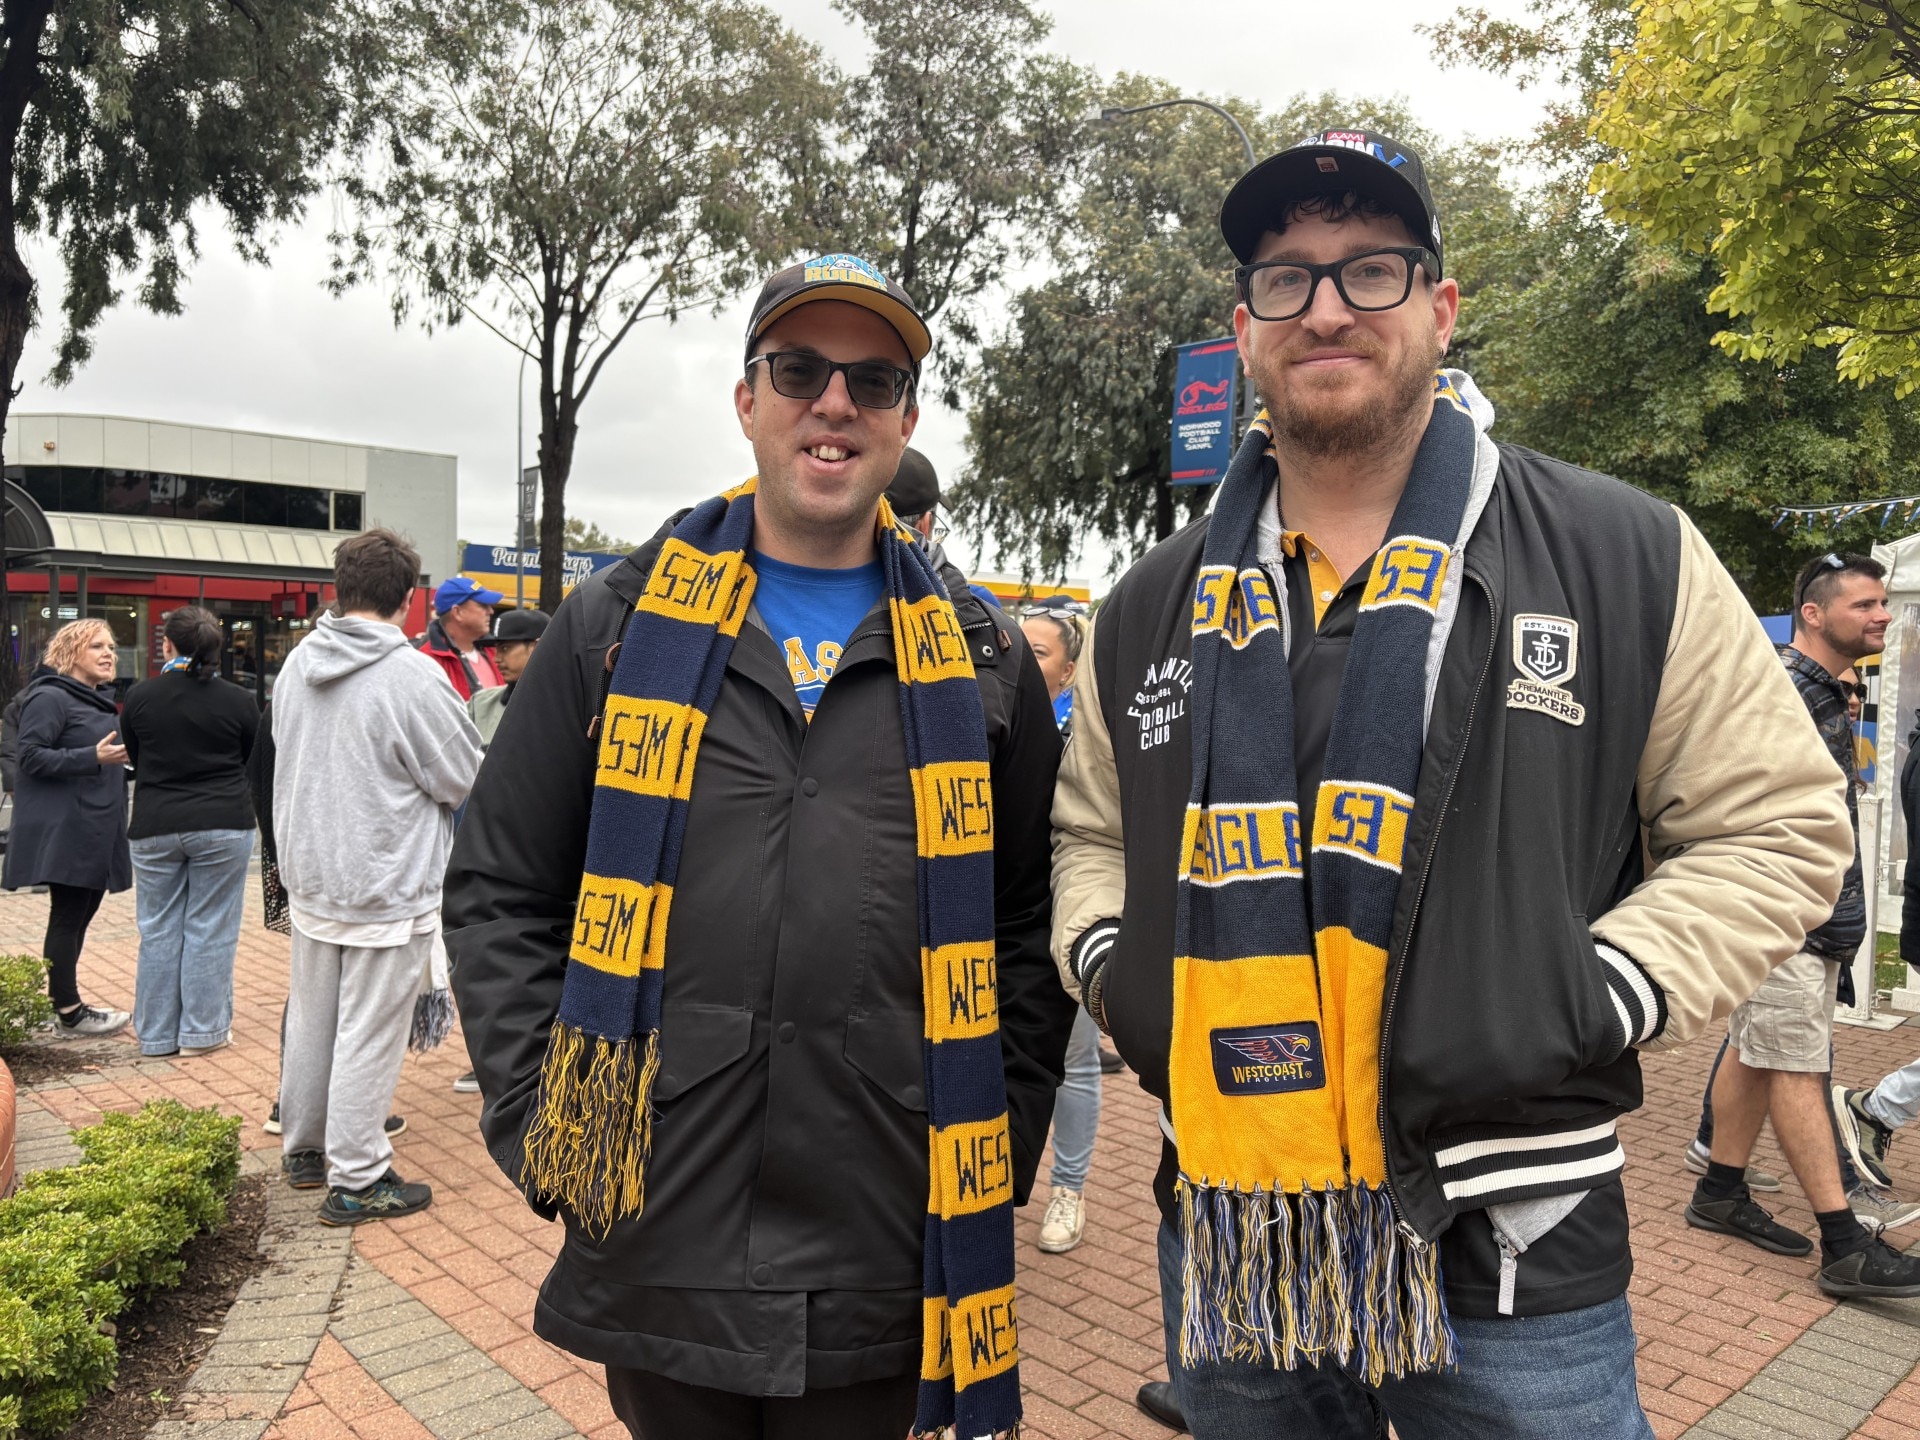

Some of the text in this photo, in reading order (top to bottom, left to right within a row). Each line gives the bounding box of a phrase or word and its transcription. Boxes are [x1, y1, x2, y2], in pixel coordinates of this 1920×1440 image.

[1329, 132, 1364, 142] AAMI
[1177, 402, 1228, 415] REDLEGS
[1178, 421, 1222, 431] NORWOOD
[1178, 428, 1221, 438] FOOTBALL
[655, 551, 727, 612] WES
[909, 608, 967, 670] WES
[1518, 683, 1568, 703] FREMANTLE
[601, 711, 673, 781] WES
[1140, 724, 1170, 750] CLUB
[936, 777, 993, 842] WES
[1190, 810, 1303, 880] EAGLE
[576, 890, 638, 962] WES
[947, 957, 998, 1025] WES
[1246, 1074, 1297, 1083] EAGLES
[955, 1130, 1009, 1202] WES
[967, 1297, 1019, 1371] WES
